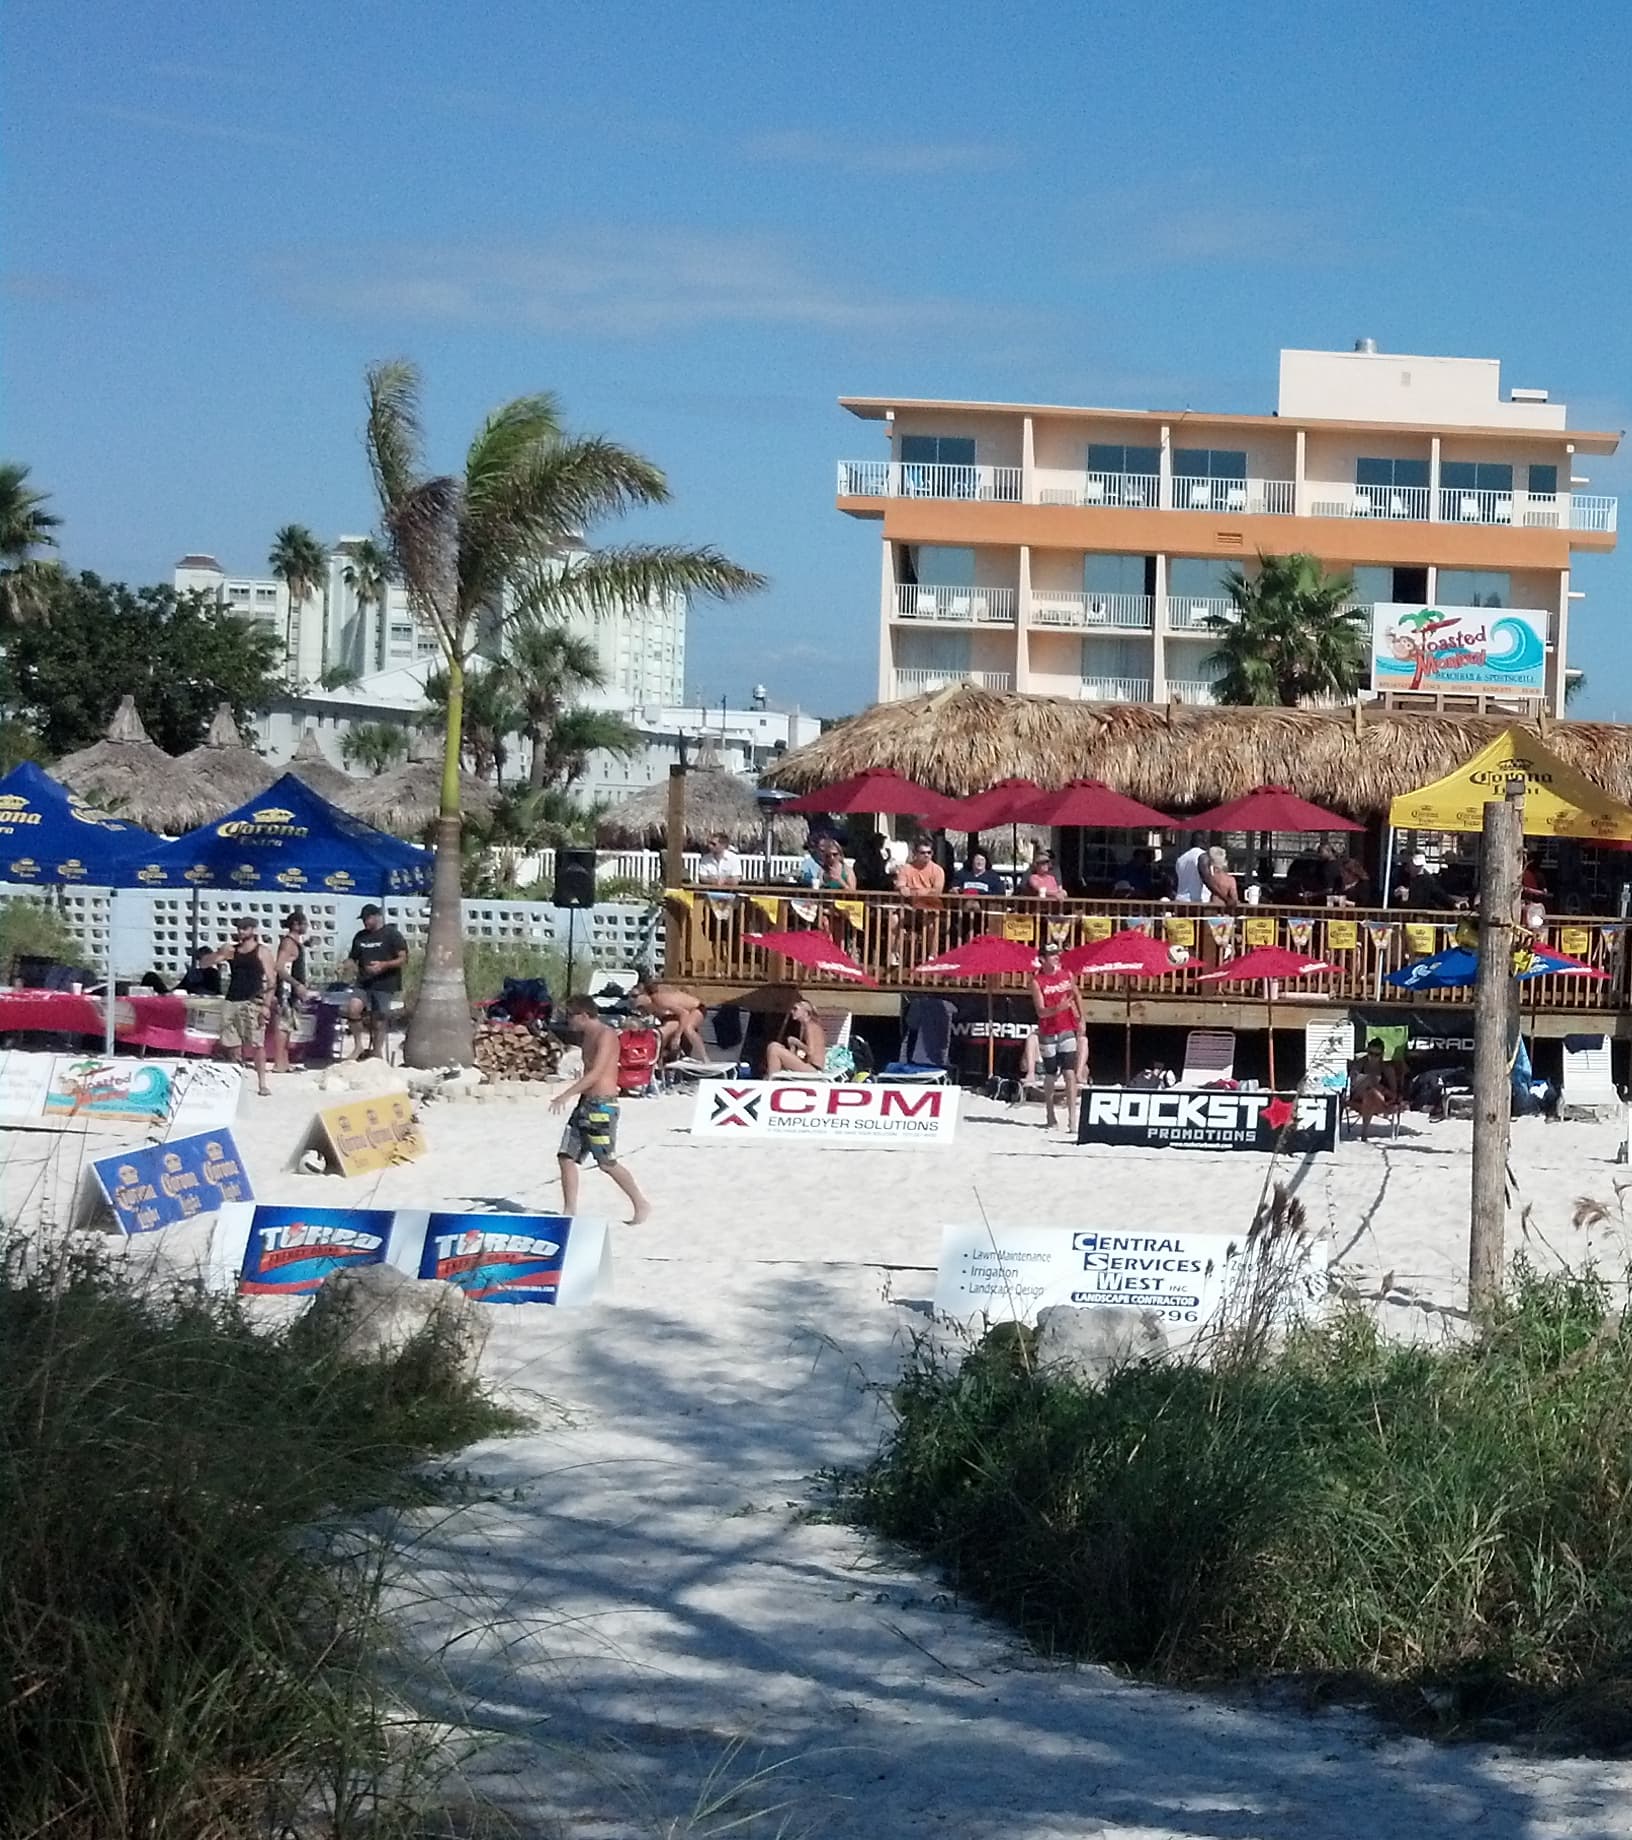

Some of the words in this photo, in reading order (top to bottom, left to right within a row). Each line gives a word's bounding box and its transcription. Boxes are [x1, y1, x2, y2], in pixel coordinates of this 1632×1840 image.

[1413, 619, 1487, 652] Toasted
[1469, 770, 1553, 785] Corona
[0, 811, 42, 825] ona
[217, 820, 309, 838] Corona
[240, 838, 282, 848] Extra
[951, 1022, 1039, 1039] WERAD
[770, 1087, 943, 1117] CPM
[768, 1116, 850, 1130] EMPLOYER
[854, 1119, 939, 1132] SOLUTIONS
[1148, 1128, 1256, 1142] PROMOTIONS
[434, 1231, 560, 1259] TURBO
[1072, 1232, 1184, 1252] CENTRAL
[973, 1248, 997, 1260] Lawn
[998, 1249, 1052, 1262] Maintenance
[1084, 1252, 1201, 1272] SERVICES
[971, 1265, 1018, 1280] Irrigation
[1097, 1271, 1164, 1291] WEST
[1015, 1284, 1044, 1299] Design
[1074, 1293, 1130, 1304] LANDSCAPE
[1131, 1294, 1195, 1306] CONTRACTOR
